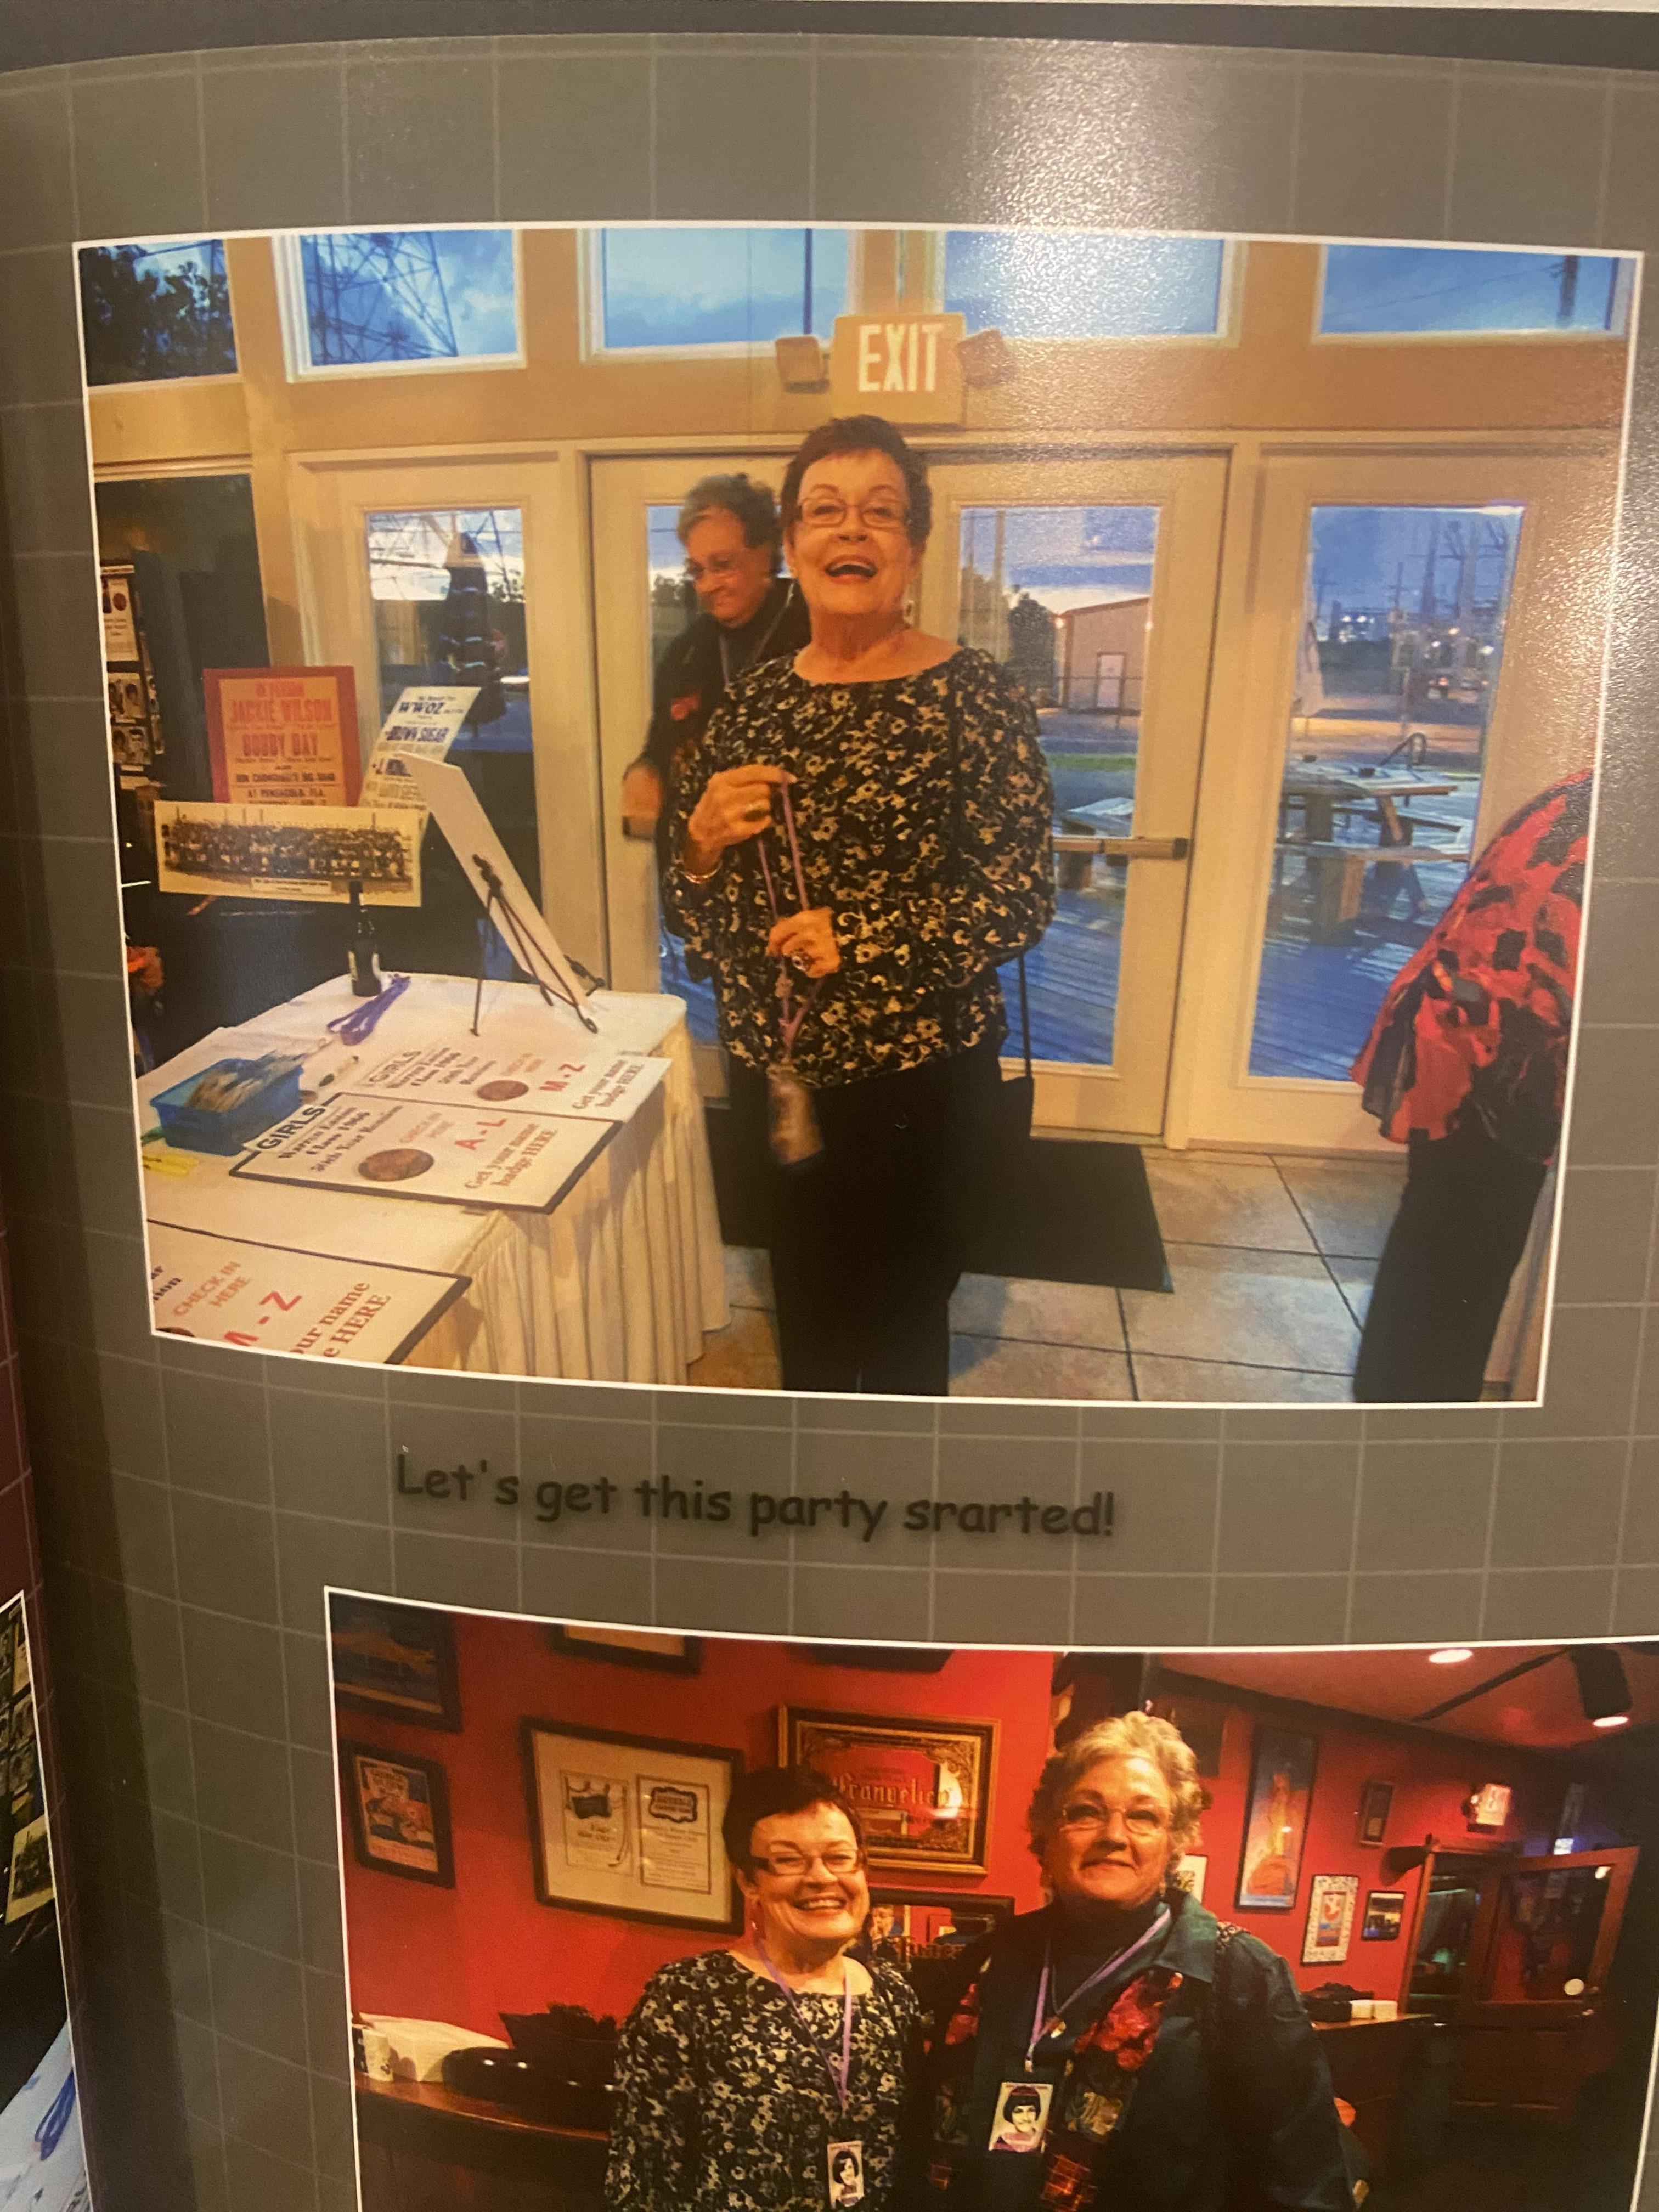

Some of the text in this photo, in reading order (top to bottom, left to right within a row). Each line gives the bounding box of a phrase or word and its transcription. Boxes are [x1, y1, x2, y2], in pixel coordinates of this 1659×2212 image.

[857, 323, 945, 392] EXIT
[399, 702, 445, 714] WWOZ
[369, 1051, 421, 1082] GIRLS
[558, 1063, 585, 1072] Z
[256, 1107, 326, 1149] GIRLS
[455, 1139, 485, 1150] A
[477, 1118, 507, 1127] L
[465, 1123, 539, 1188] Get your name
[491, 1130, 557, 1186] badge HERE
[173, 1262, 241, 1315] CHECK IN
[209, 1276, 252, 1307] HERE
[259, 1291, 302, 1311] Z
[289, 1283, 370, 1354] our name
[330, 1294, 391, 1344] HERE
[397, 1453, 1114, 1542] Let's get this party srarted!
